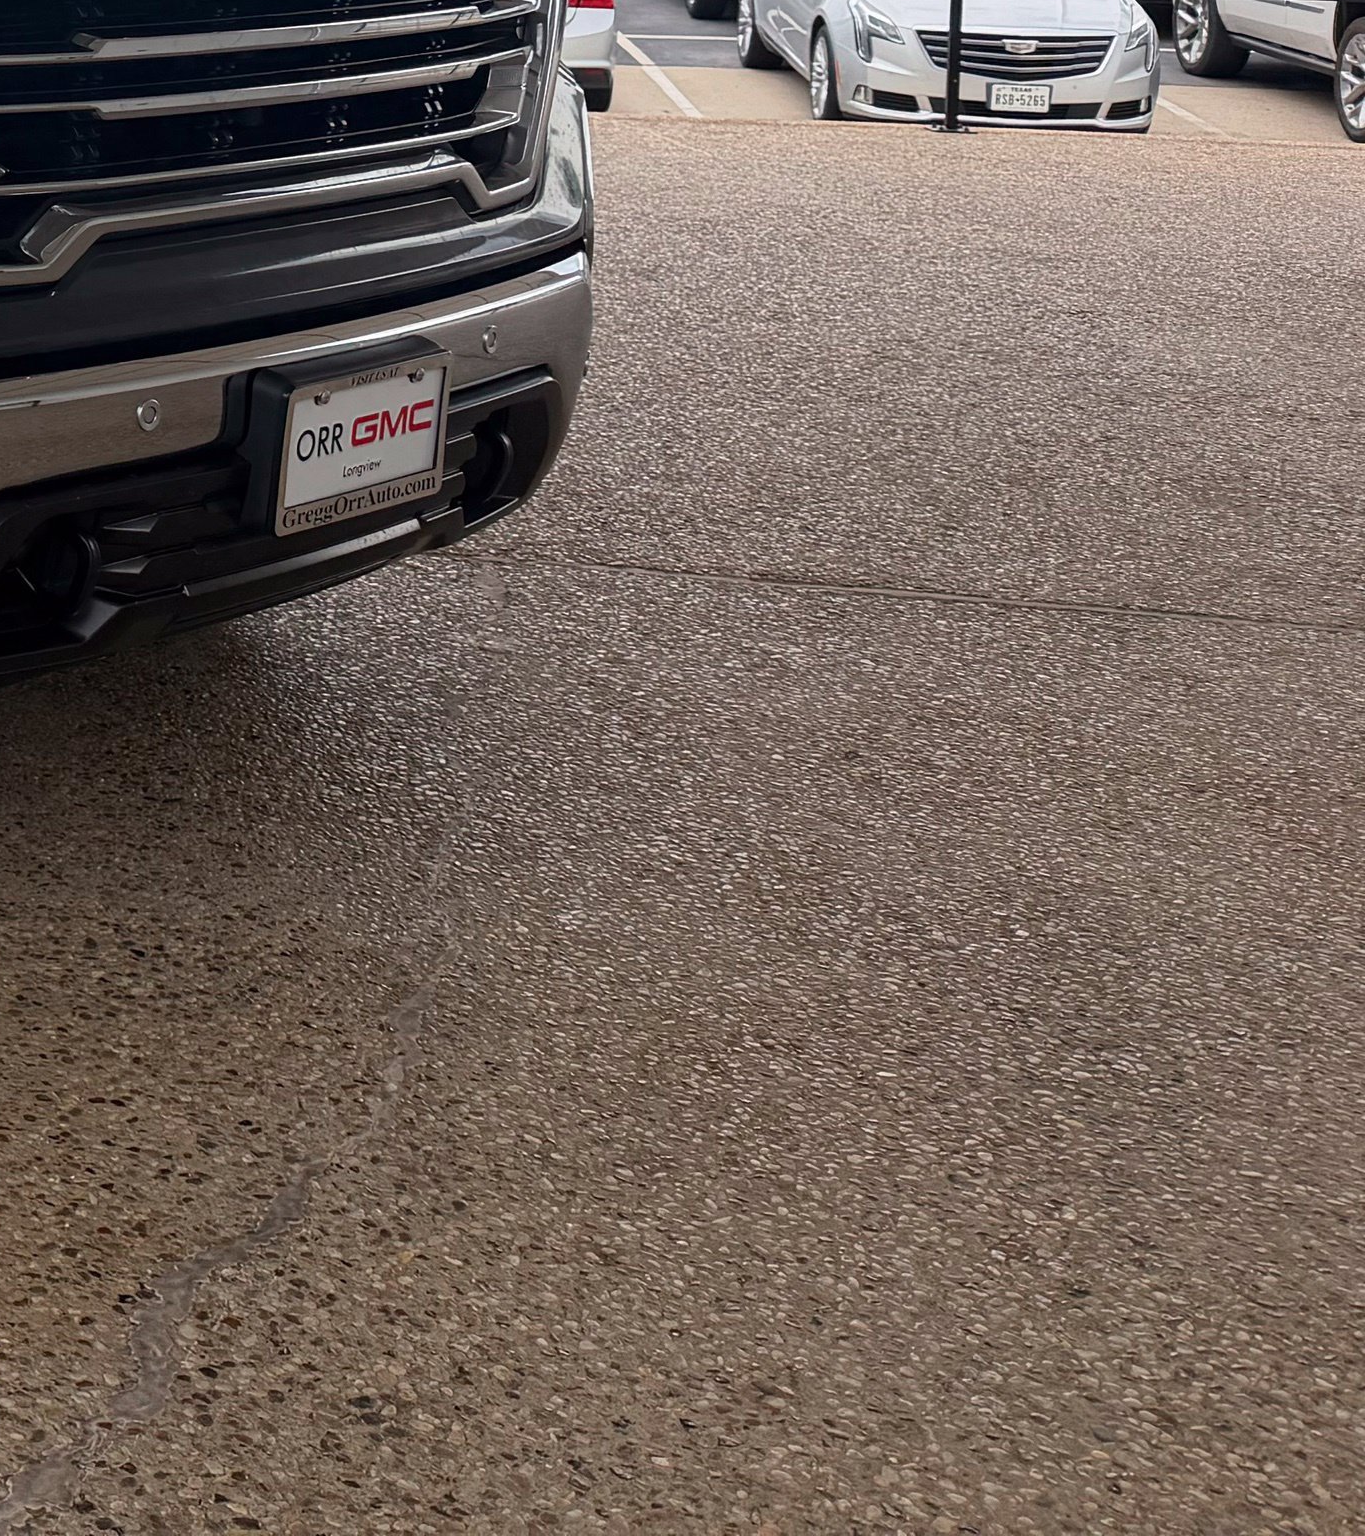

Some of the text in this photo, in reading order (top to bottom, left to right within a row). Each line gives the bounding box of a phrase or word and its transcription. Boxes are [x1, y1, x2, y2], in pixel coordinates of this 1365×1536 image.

[296, 398, 435, 462] ORR GMC
[342, 459, 382, 478] Longview
[281, 475, 436, 530] GreggOrrAuto.com
